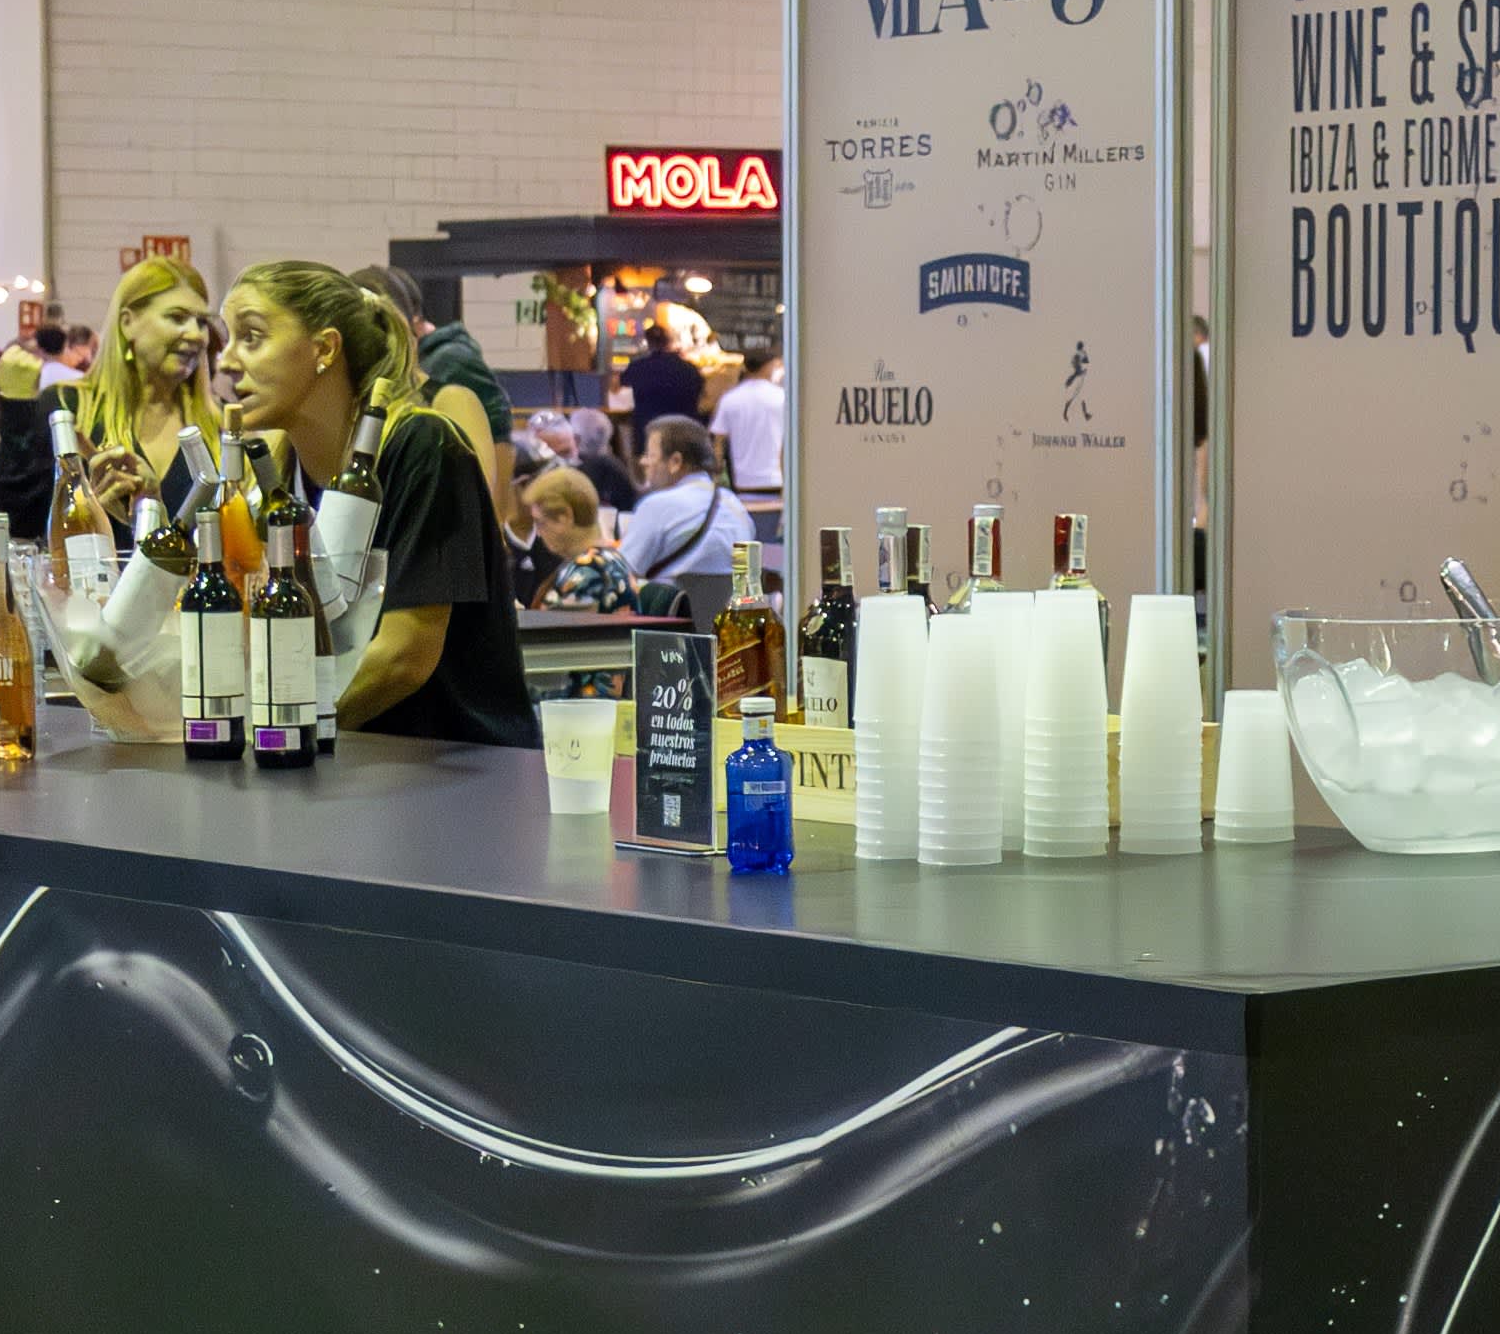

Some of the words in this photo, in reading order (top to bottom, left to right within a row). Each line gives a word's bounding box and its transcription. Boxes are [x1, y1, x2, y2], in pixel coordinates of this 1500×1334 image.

[1290, 5, 1387, 113] WINE
[1409, 1, 1436, 106] &
[825, 134, 932, 162] TORRES
[977, 142, 1055, 168] MARTIN
[1063, 144, 1145, 164] MILLER'S
[1290, 123, 1359, 194] IBIZA
[1371, 119, 1392, 190] &
[612, 155, 779, 209] MOLA
[1044, 174, 1077, 191] GIN
[927, 263, 1022, 300] SMIRNOFF
[836, 386, 934, 426] ABUELO
[652, 678, 694, 711] 20%
[651, 714, 664, 728] en
[666, 713, 694, 732] todos
[650, 733, 696, 750] nuestros
[649, 749, 697, 769] productos
